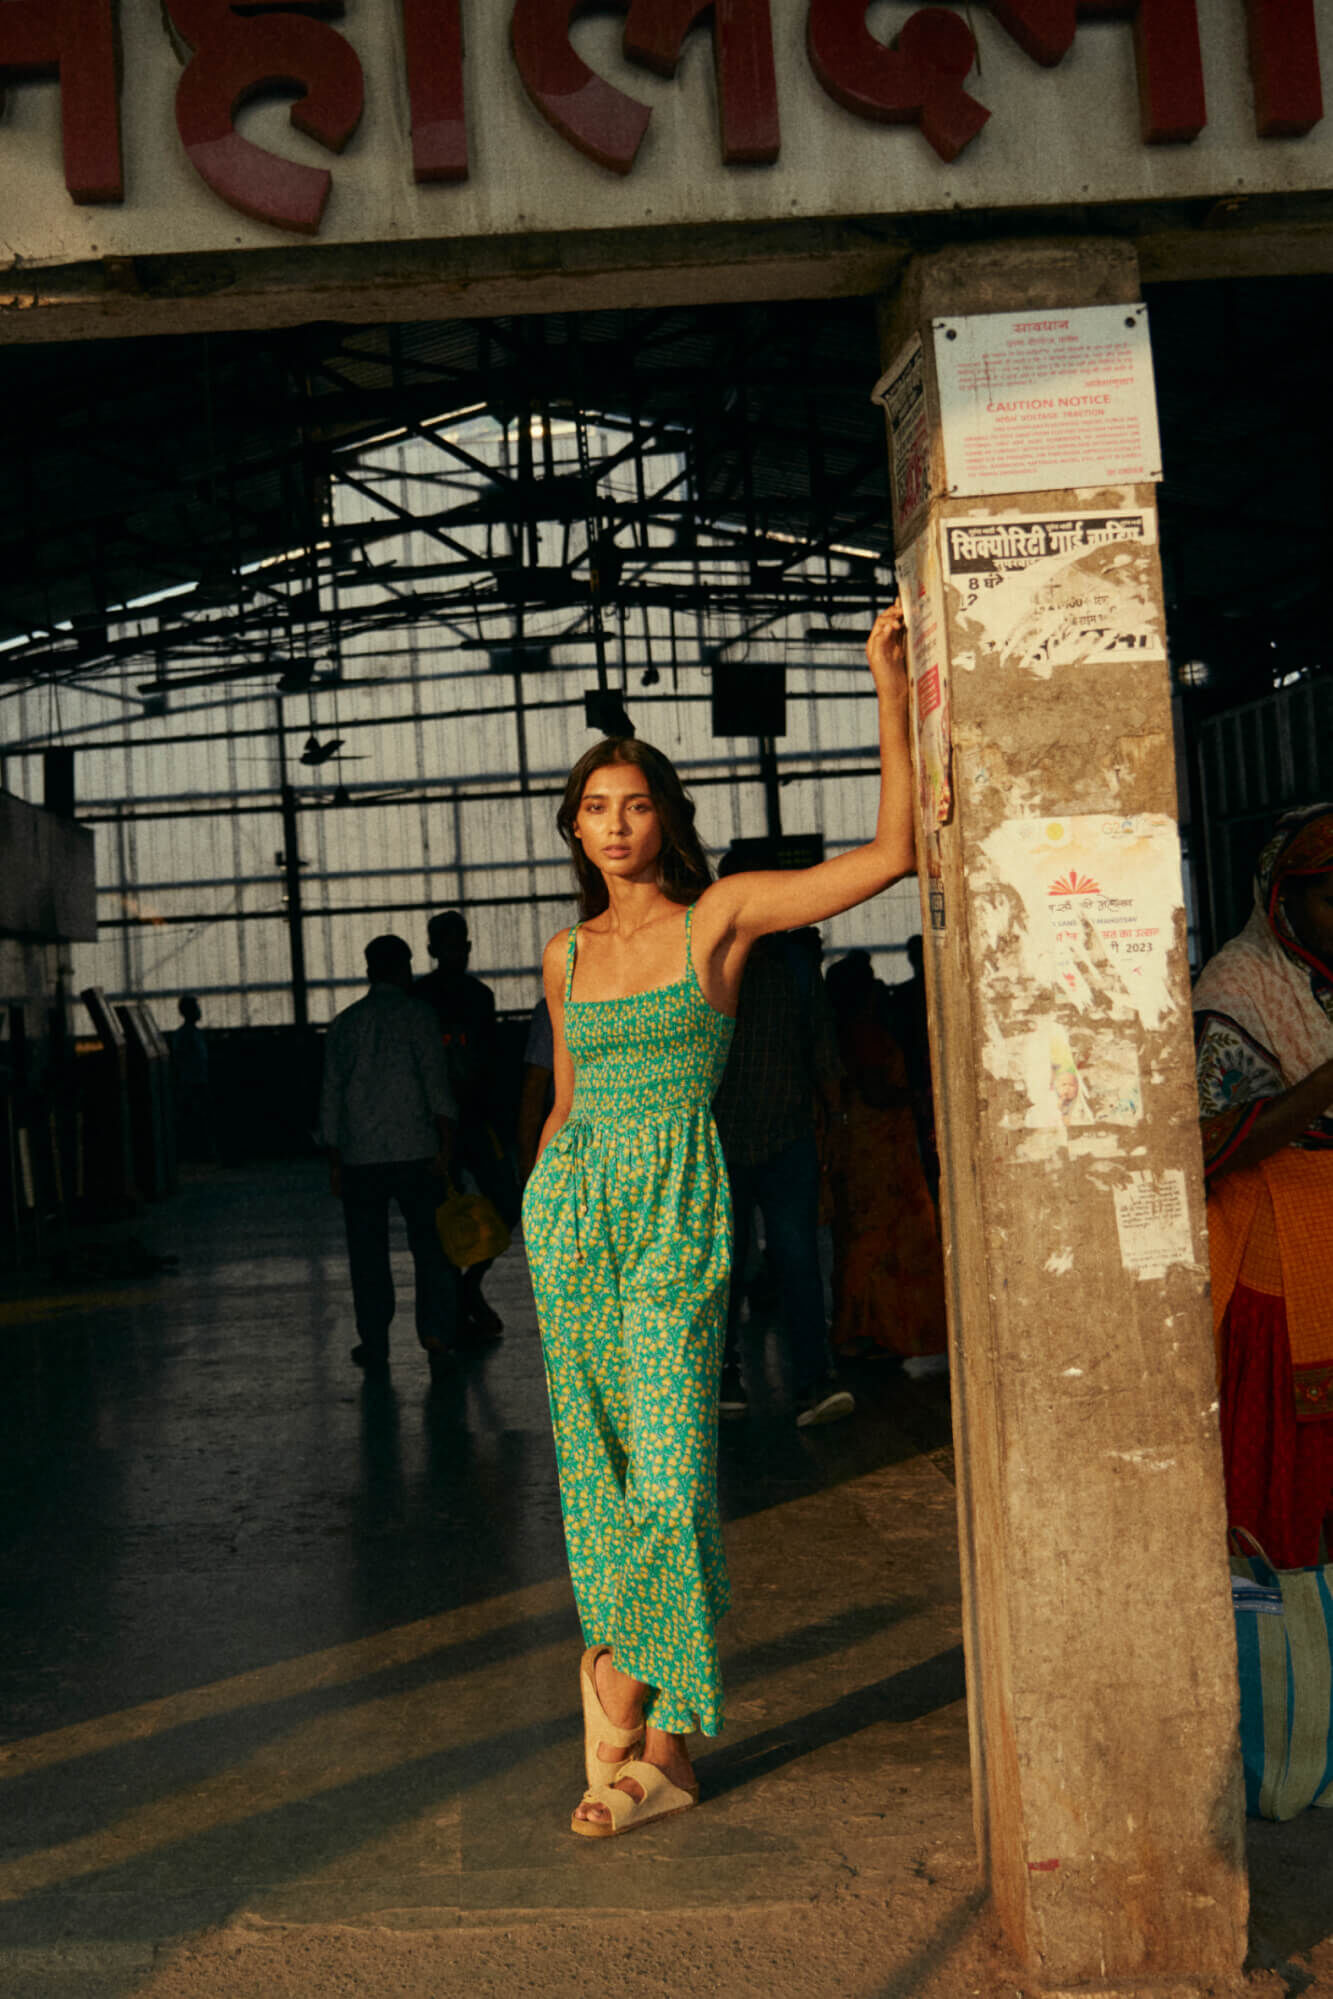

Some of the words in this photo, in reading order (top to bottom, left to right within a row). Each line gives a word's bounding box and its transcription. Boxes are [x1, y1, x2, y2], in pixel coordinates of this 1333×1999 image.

[1012, 319, 1070, 334] सावधान
[986, 399, 1054, 414] CAUTION
[1058, 394, 1112, 407] NOTICE
[968, 577, 980, 590] 8
[1125, 942, 1153, 952] 2023
